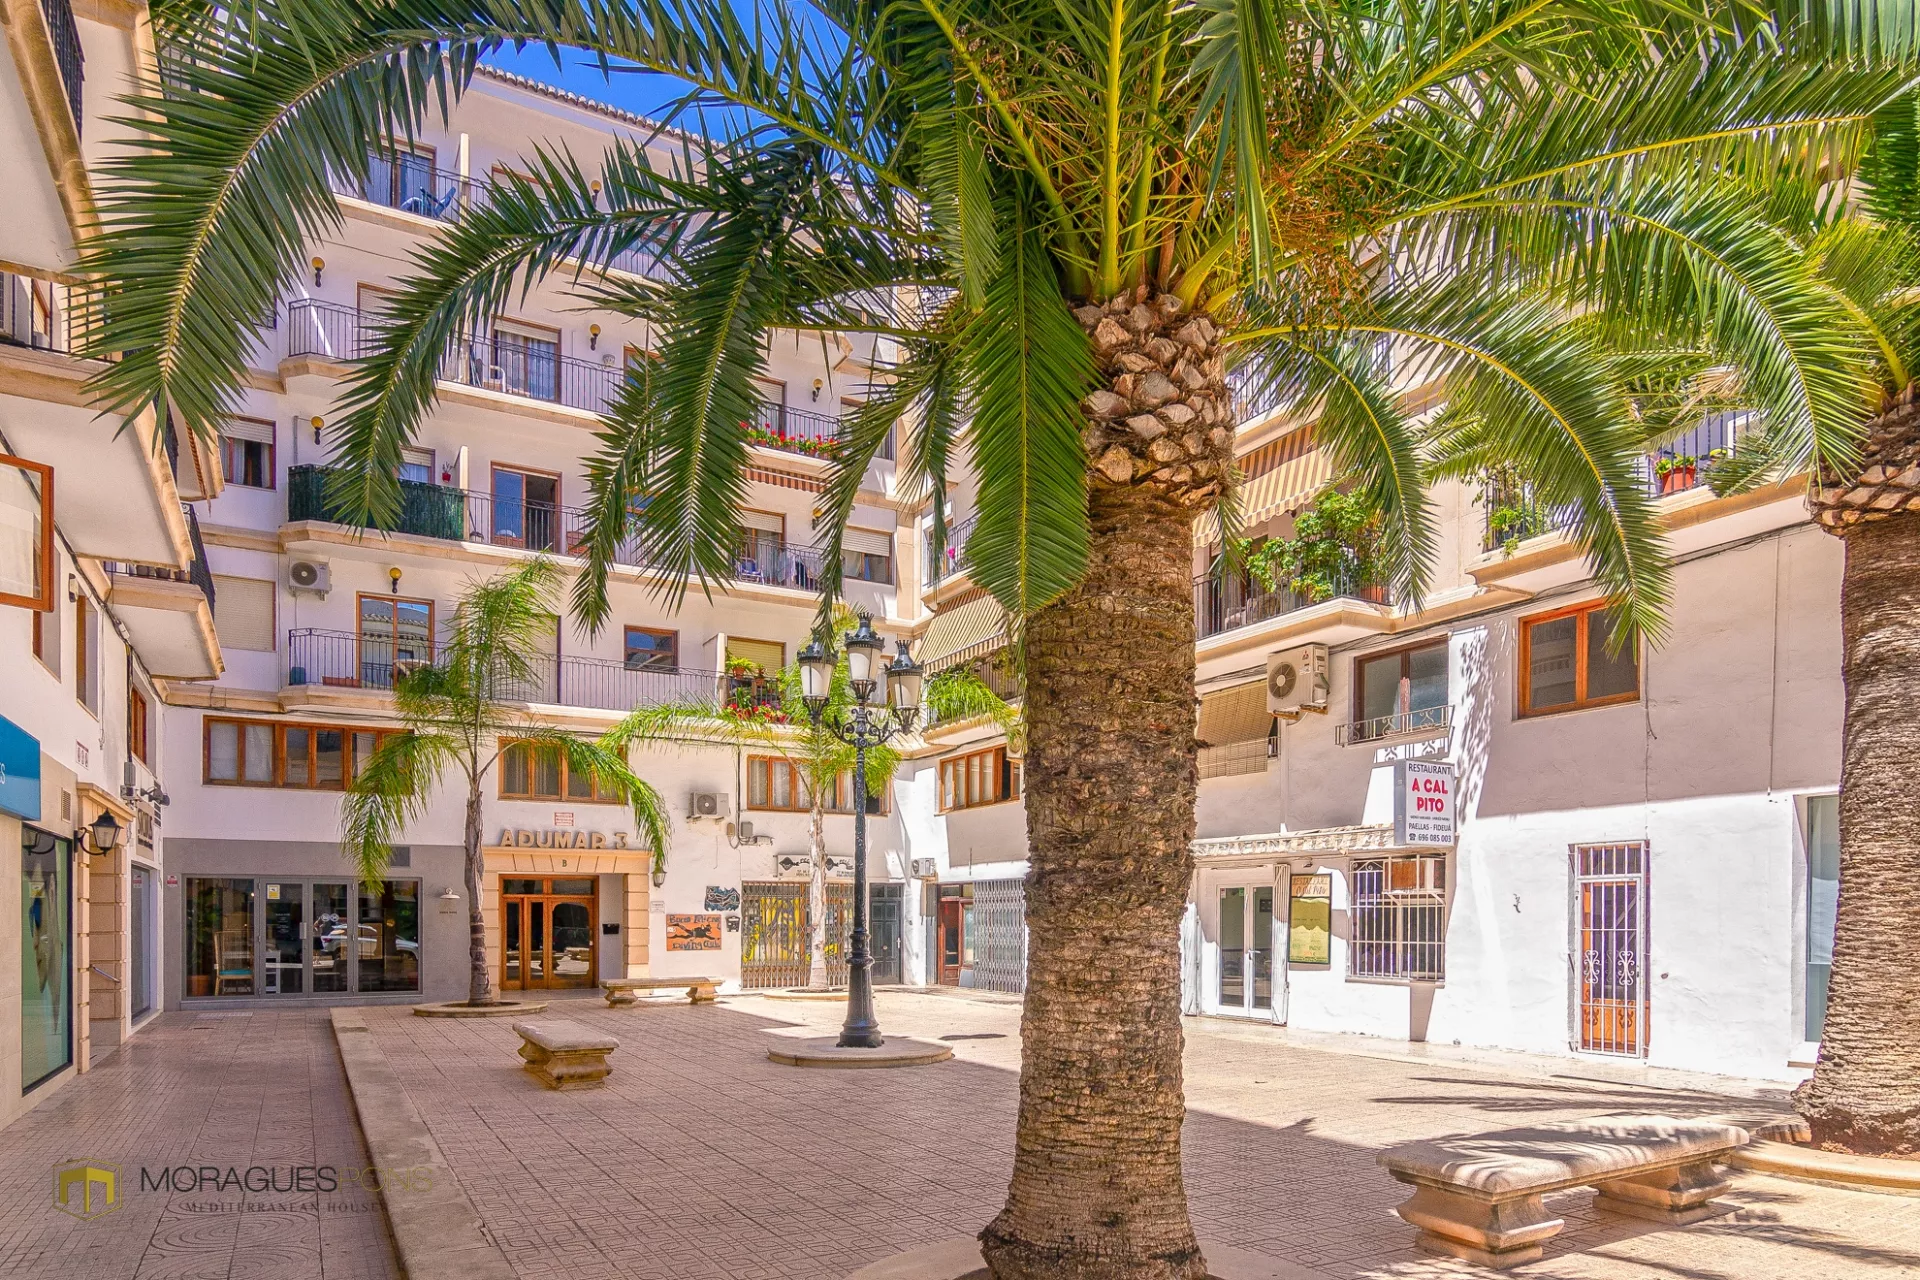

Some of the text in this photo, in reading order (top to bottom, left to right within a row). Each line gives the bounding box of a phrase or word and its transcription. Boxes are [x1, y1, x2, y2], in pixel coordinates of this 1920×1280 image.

[1408, 763, 1451, 775] RESTAURANT
[1412, 777, 1448, 794] A CAL
[1416, 796, 1444, 813] PITO
[1408, 822, 1430, 831] PAELLAS
[500, 828, 629, 849] ADUMAR 3
[1418, 833, 1452, 843] 696 085 003
[562, 859, 568, 867] B
[672, 939, 703, 950] Diving
